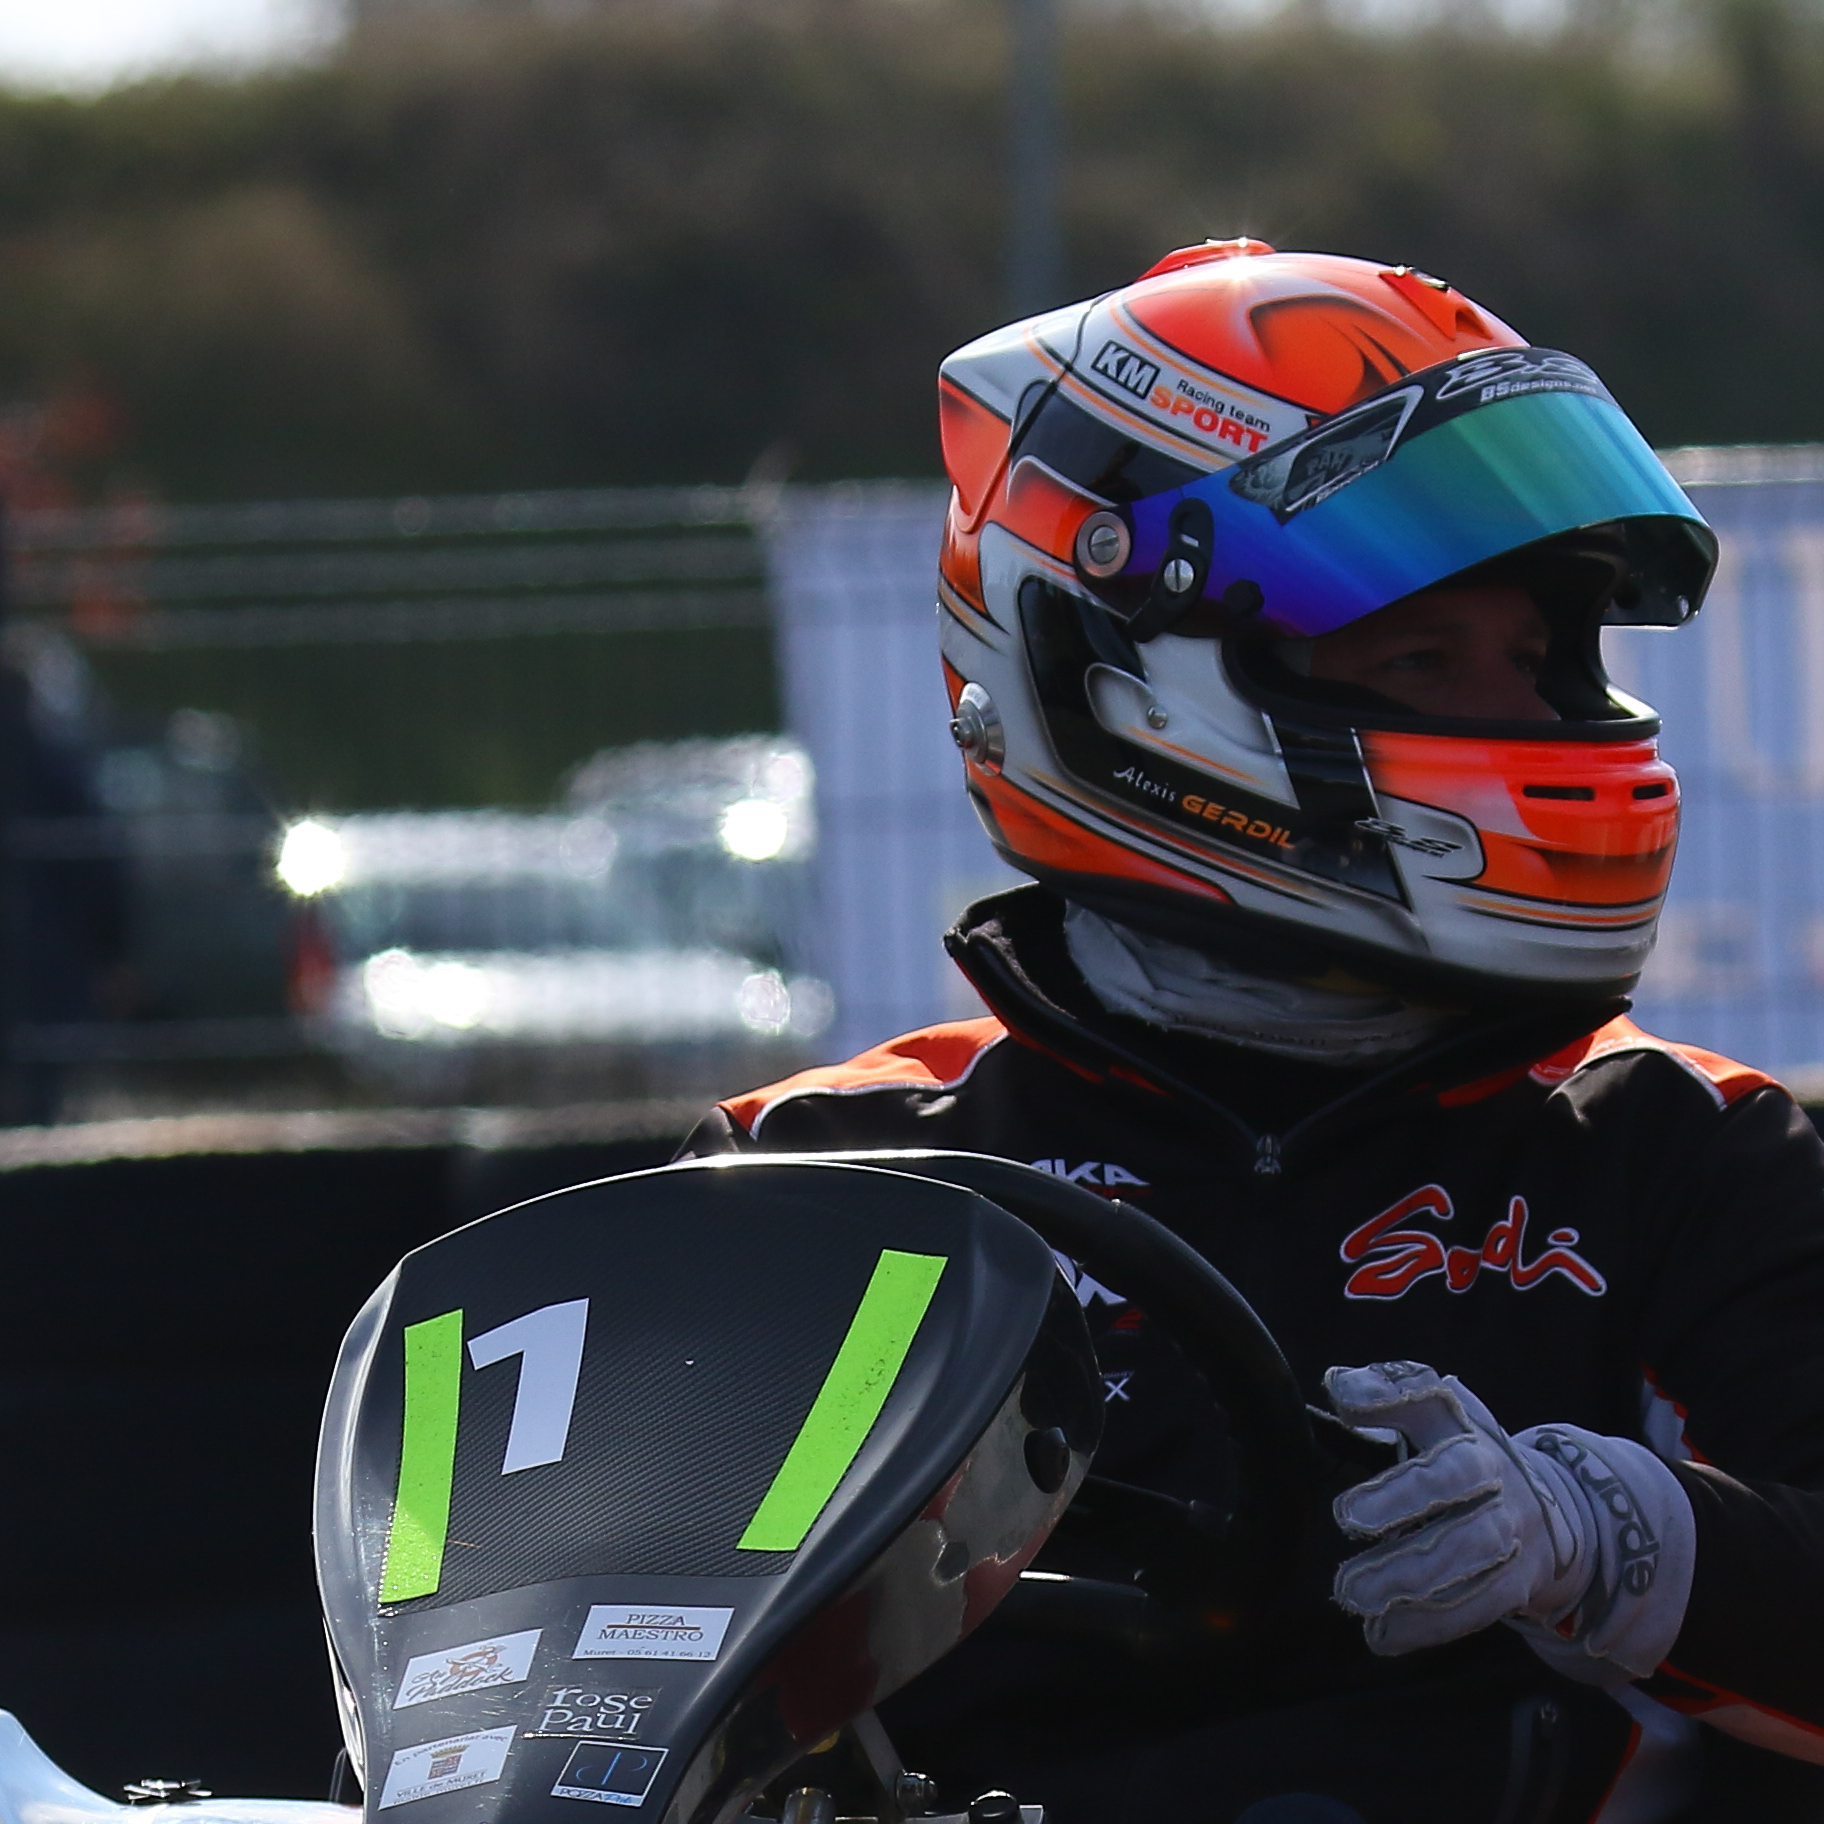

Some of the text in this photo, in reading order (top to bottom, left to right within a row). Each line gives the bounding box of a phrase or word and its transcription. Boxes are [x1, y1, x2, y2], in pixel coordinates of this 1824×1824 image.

[1095, 343, 1154, 397] KM
[1150, 384, 1269, 453] SPORT
[1176, 379, 1271, 432] Racing team
[1113, 766, 1177, 801] Alexis
[1181, 794, 1295, 849] GERDIL
[1340, 1183, 1607, 1300] Sodi
[467, 1297, 589, 1475] 1
[597, 1629, 704, 1642] MAESTRO
[627, 1614, 685, 1626] PIZZA
